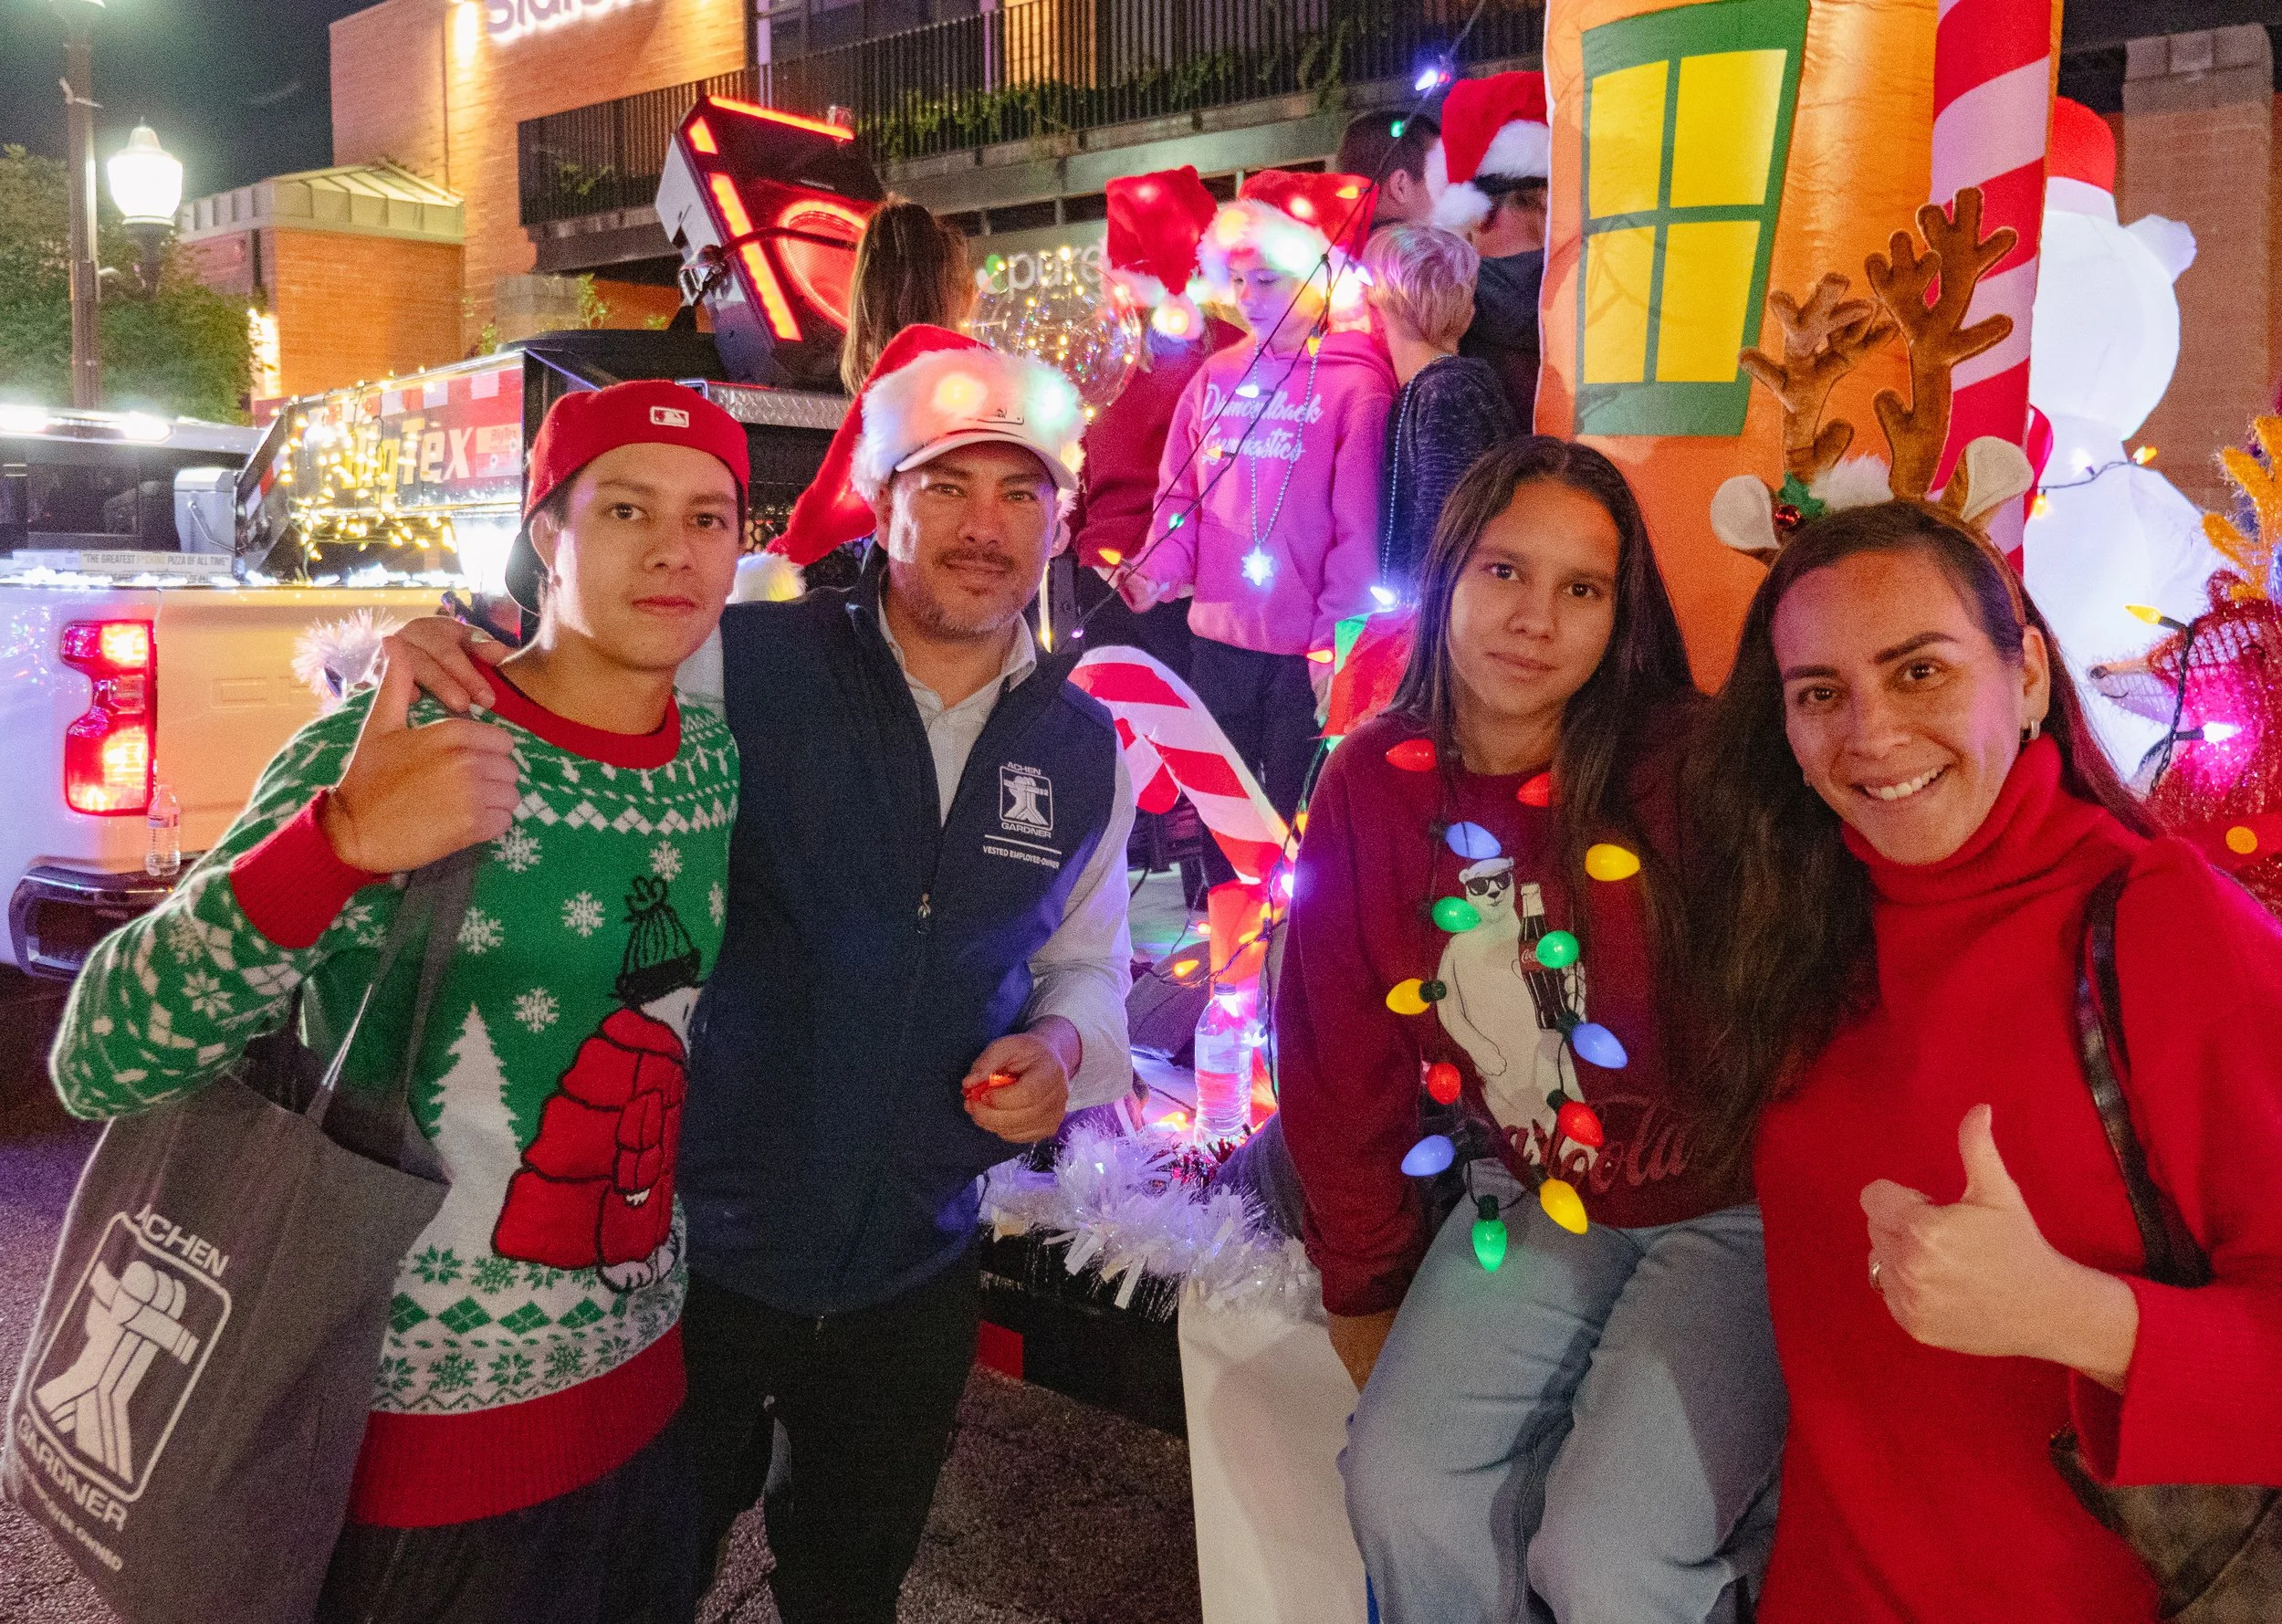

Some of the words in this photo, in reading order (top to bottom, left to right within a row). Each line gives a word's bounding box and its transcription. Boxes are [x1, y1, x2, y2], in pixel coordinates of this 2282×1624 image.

[101, 553, 136, 564] GREATEST
[167, 556, 185, 566] PIZZA
[187, 557, 195, 566] OF
[196, 557, 208, 566] ALL
[1007, 761, 1042, 776] ACHEN
[1000, 822, 1052, 838] GARDNER
[983, 845, 1009, 856] VESTED
[17, 1414, 128, 1532] GARDNER
